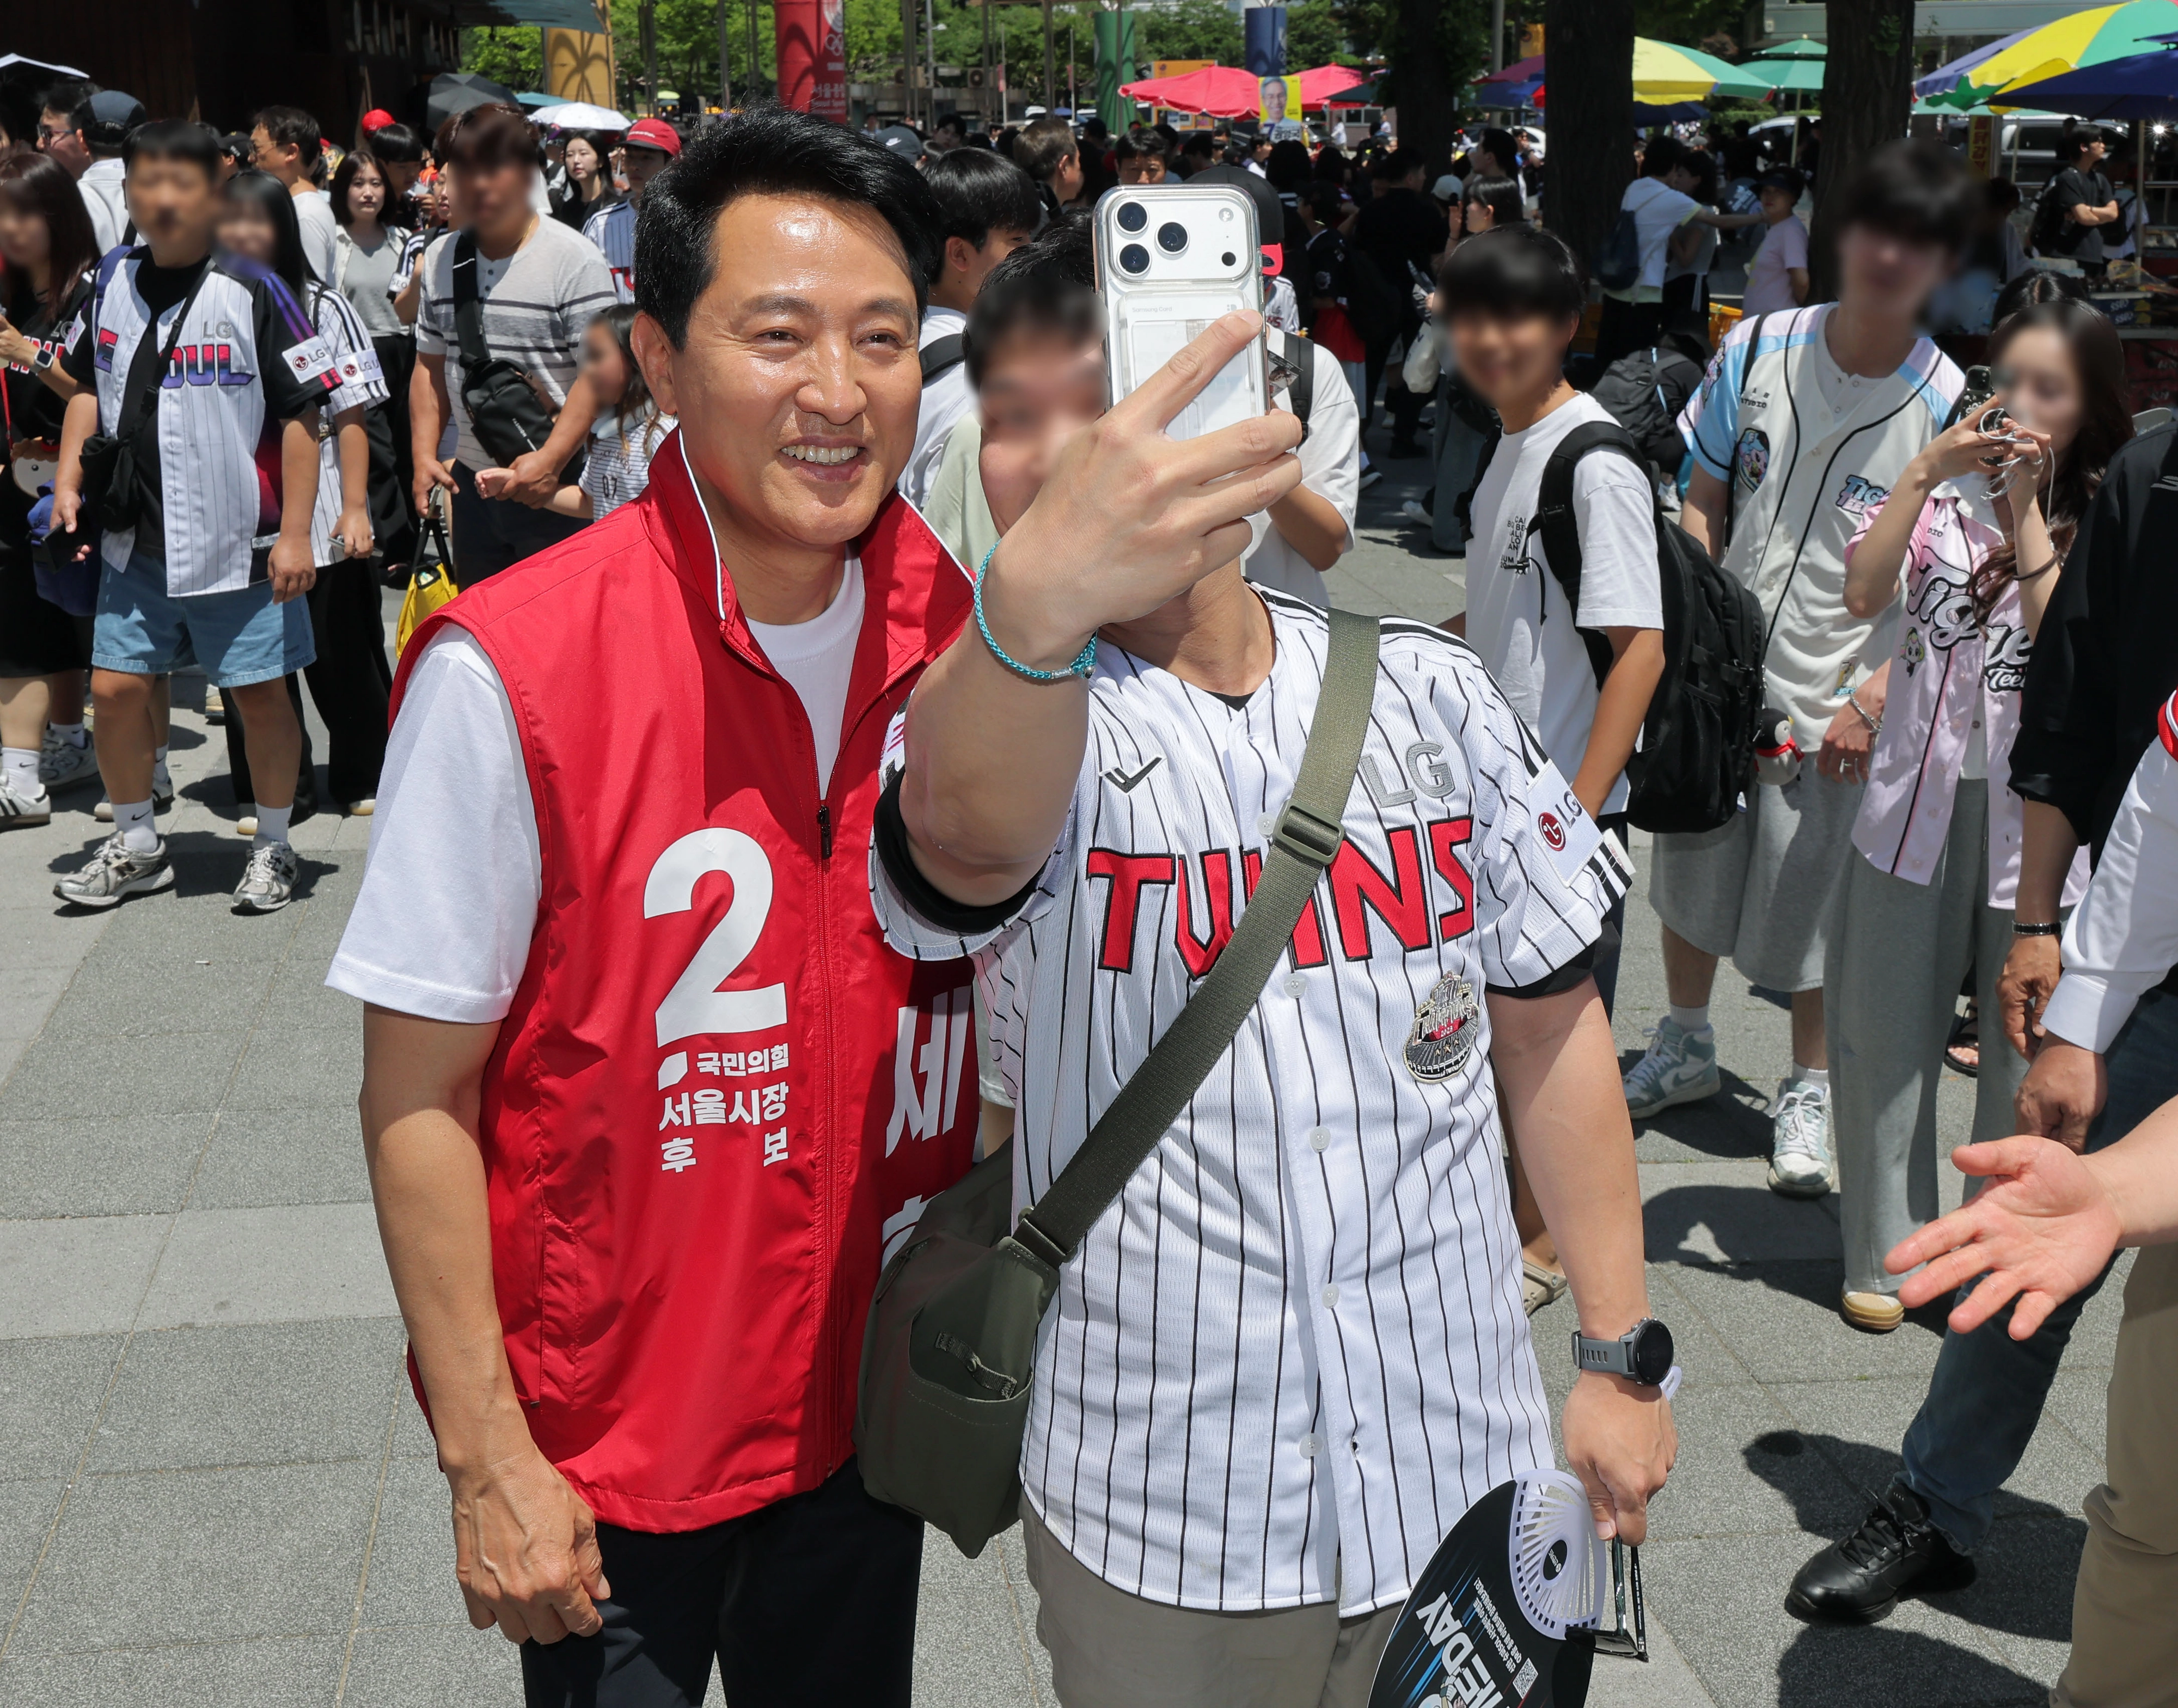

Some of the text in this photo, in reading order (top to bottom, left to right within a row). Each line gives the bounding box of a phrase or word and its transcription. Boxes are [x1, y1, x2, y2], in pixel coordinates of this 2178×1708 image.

[203, 321, 232, 338] LG
[307, 348, 326, 363] LG
[358, 362, 372, 371] LG
[1358, 742, 1455, 808] LG
[1555, 790, 1582, 829] LG
[644, 827, 788, 1048] 2
[696, 1043, 789, 1077] 국민의힘
[659, 1081, 789, 1131] 서울시장
[1473, 1577, 1522, 1663] QR을 통해 이벤트에 참여해보세요!
[1473, 1597, 1516, 1674] 신한 슈퍼SOL 사전예약 이벤트
